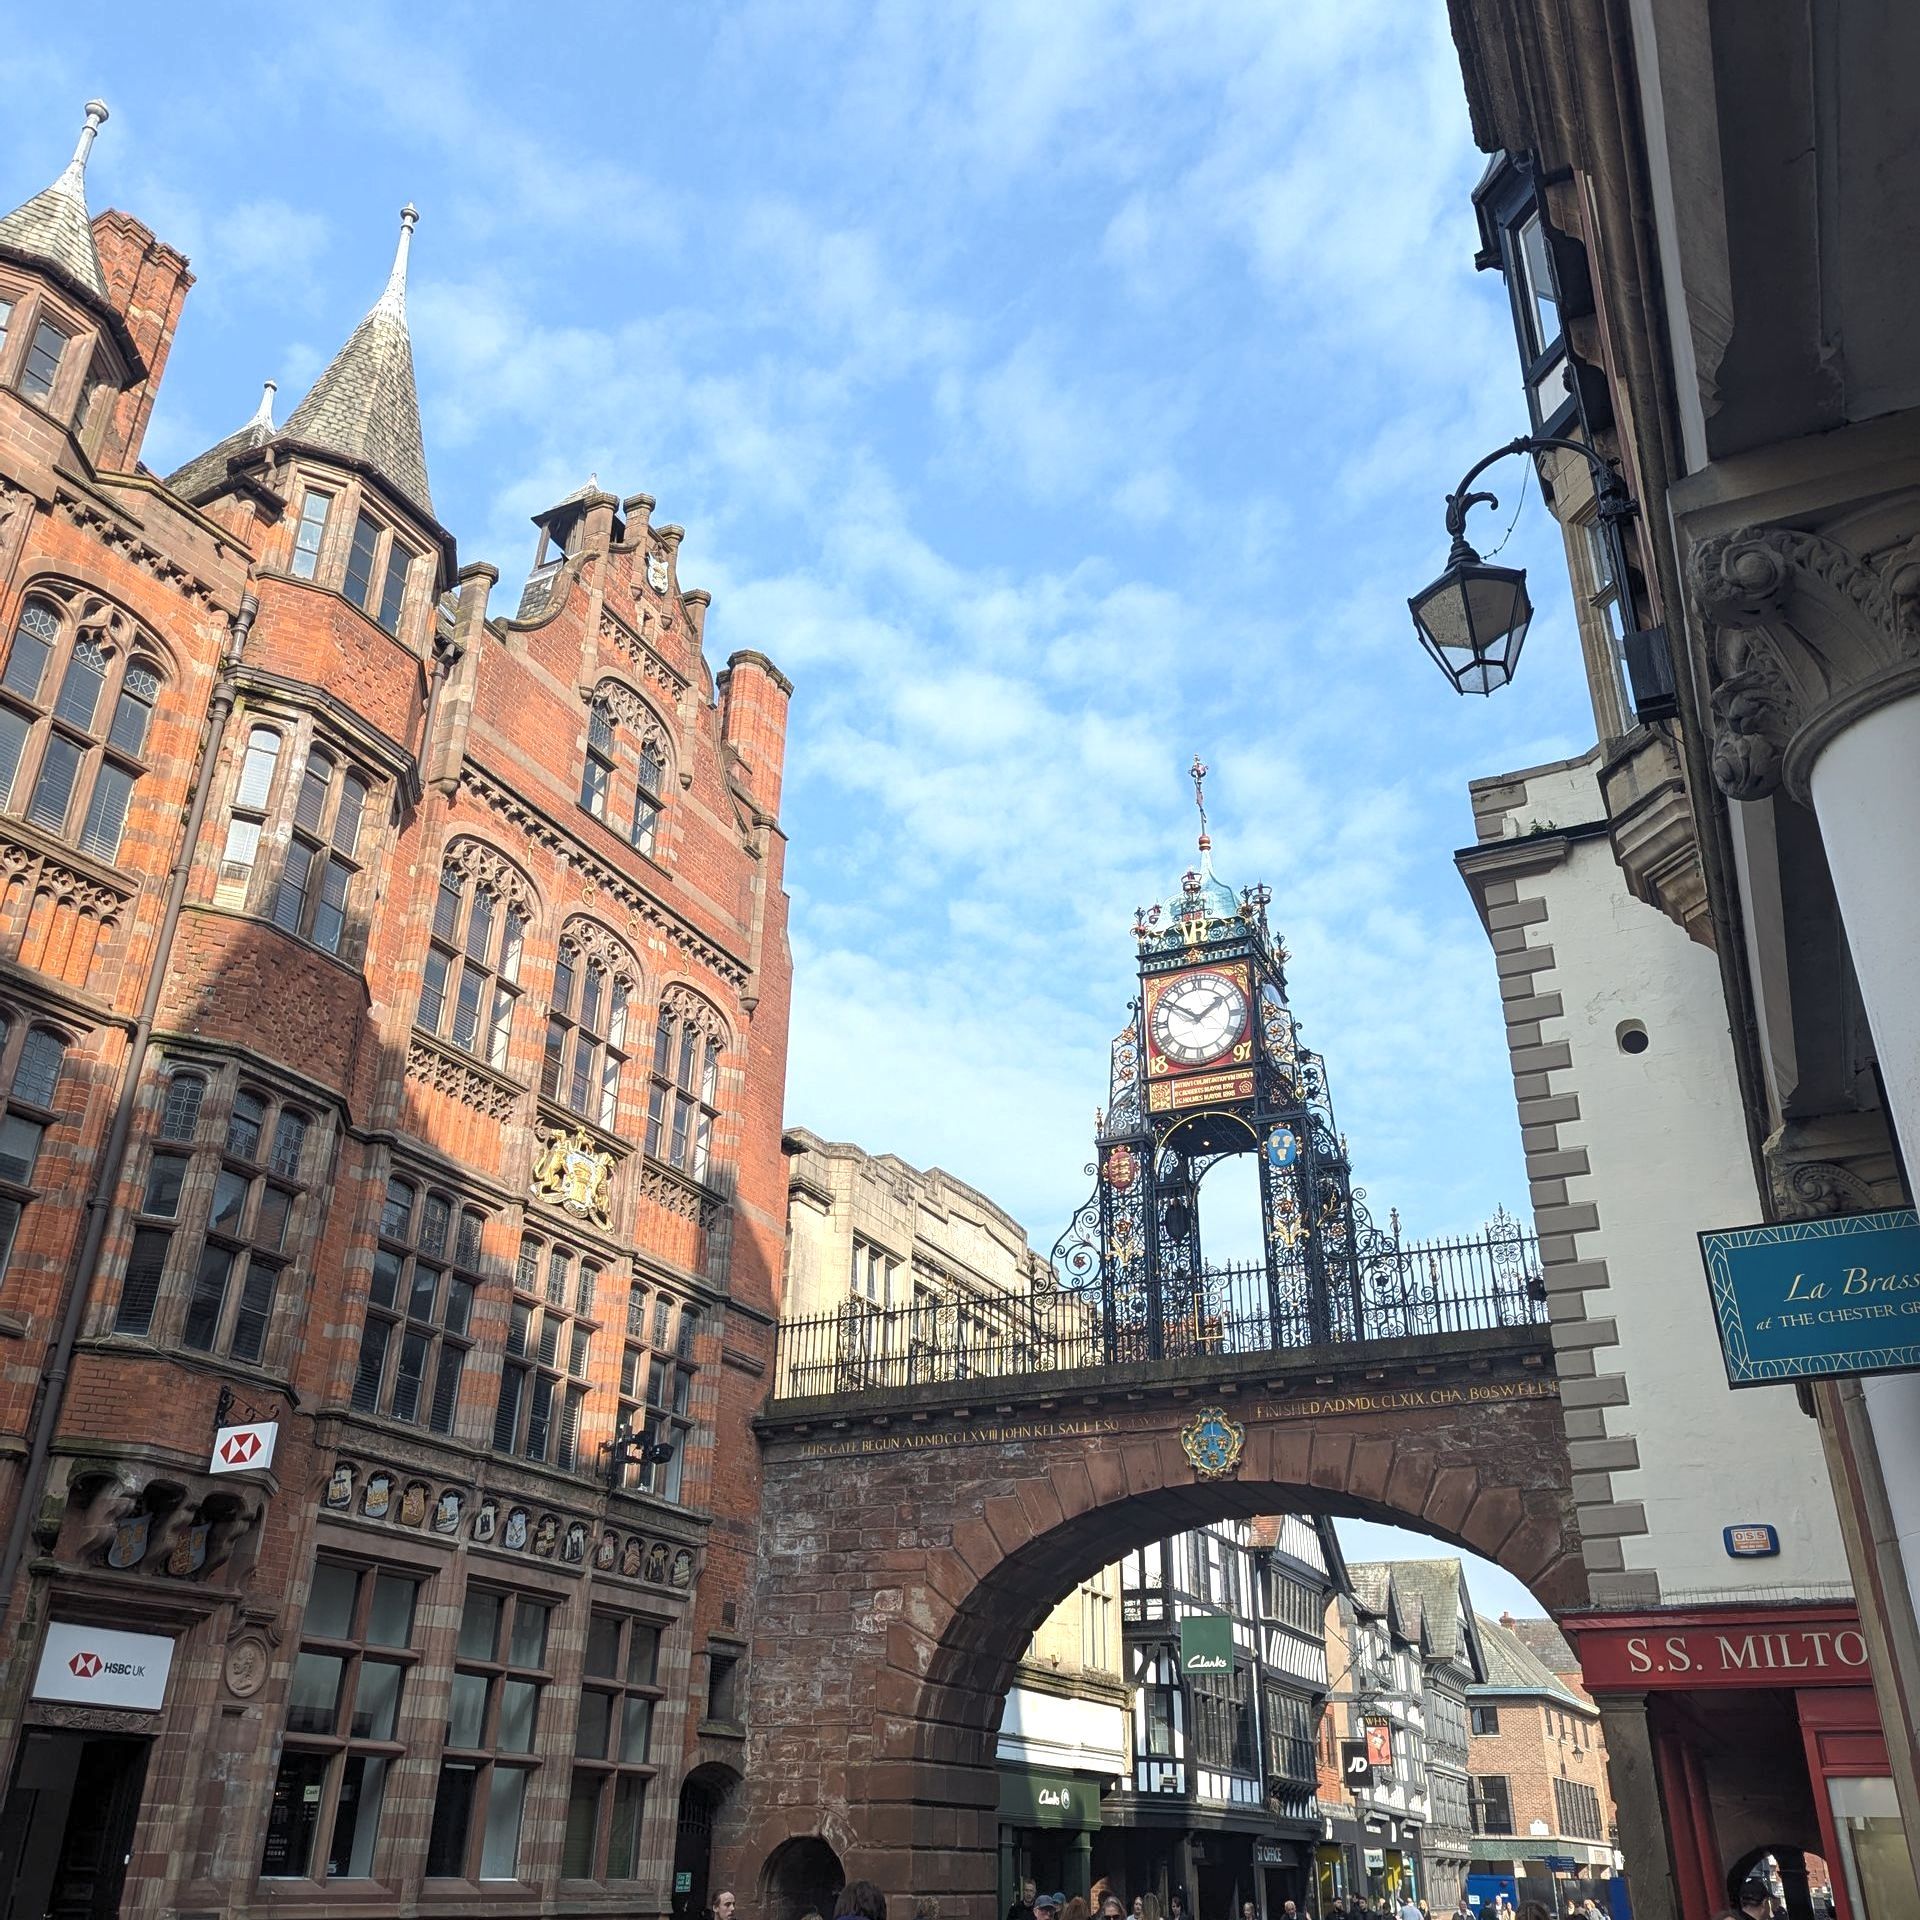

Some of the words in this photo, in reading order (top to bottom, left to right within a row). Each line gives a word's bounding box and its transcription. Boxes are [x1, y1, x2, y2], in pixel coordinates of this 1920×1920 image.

[1180, 919, 1208, 945] VR
[1232, 1041, 1252, 1062] 97
[1149, 1055, 1168, 1075] 18
[1783, 1273, 1832, 1302] La
[1842, 1267, 1920, 1296] Brass
[1756, 1315, 1772, 1331] at
[1778, 1313, 1815, 1328] THE
[1818, 1304, 1897, 1323] CHESTER
[1257, 1400, 1320, 1418] FINISHED
[1469, 1381, 1548, 1400] BOSWELL
[829, 1440, 857, 1455] GATE
[862, 1438, 900, 1452] BEGUN
[1001, 1425, 1031, 1442] JOHN
[1034, 1421, 1090, 1437] KELSALL
[1187, 1654, 1227, 1669] Clarks
[1627, 1637, 1703, 1672] S.S.
[1715, 1631, 1868, 1670] MILTO
[104, 1662, 132, 1675] HSBC
[132, 1665, 146, 1677] UK
[1365, 1717, 1388, 1726] WHS
[1347, 1756, 1368, 1773] JD
